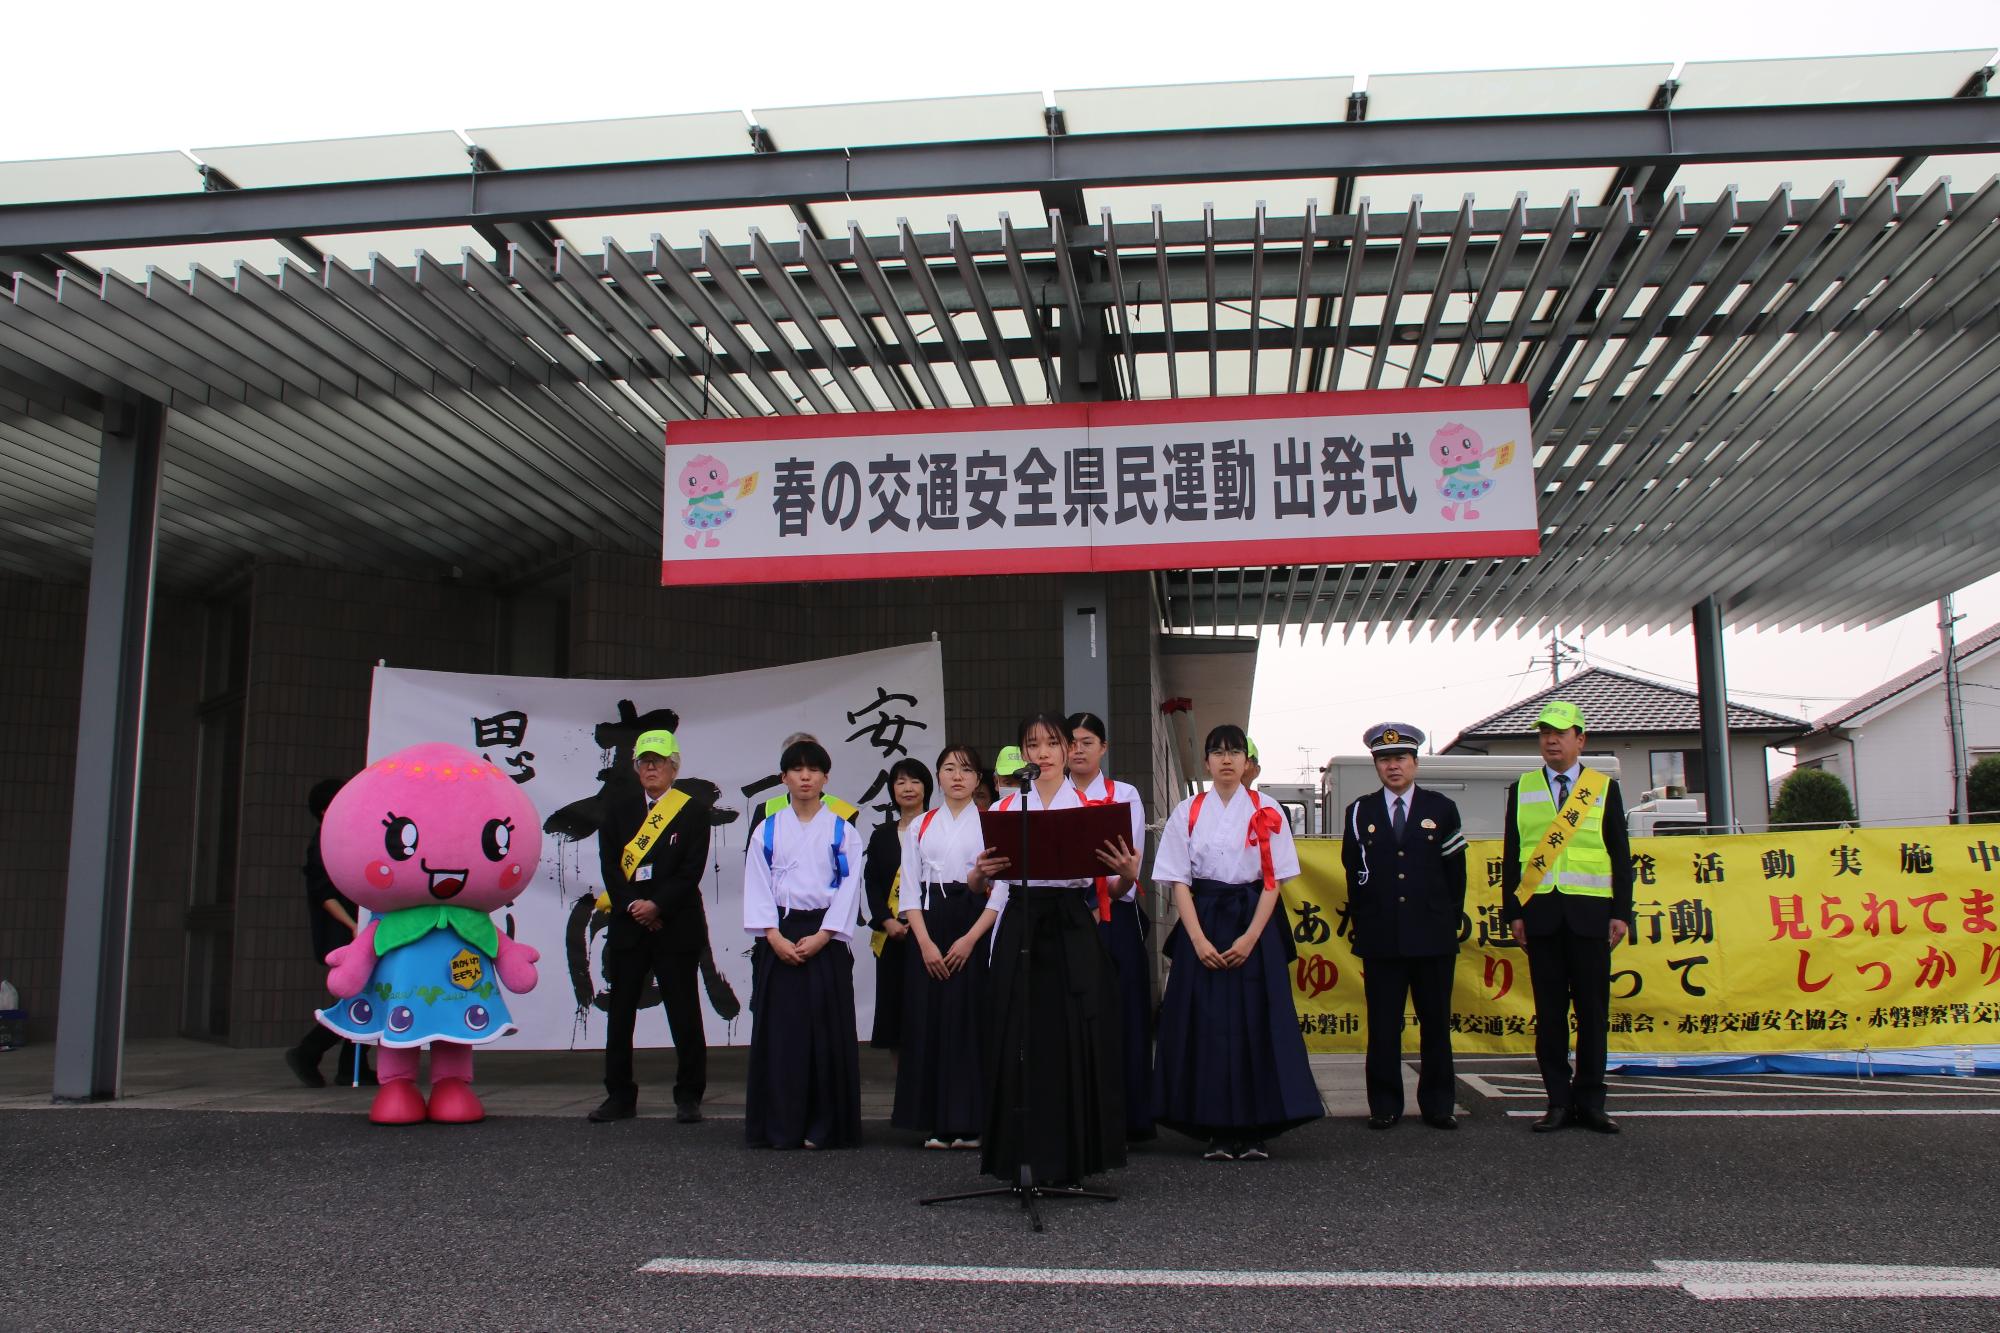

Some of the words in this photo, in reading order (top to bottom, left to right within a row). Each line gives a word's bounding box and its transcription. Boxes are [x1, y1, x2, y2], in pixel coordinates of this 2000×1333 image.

[773, 439, 1256, 538] 春の交通安全県民運動
[1273, 432, 1417, 520] 出発式
[1532, 787, 1592, 873] 交通安全
[1768, 889, 1997, 942] 見られてま
